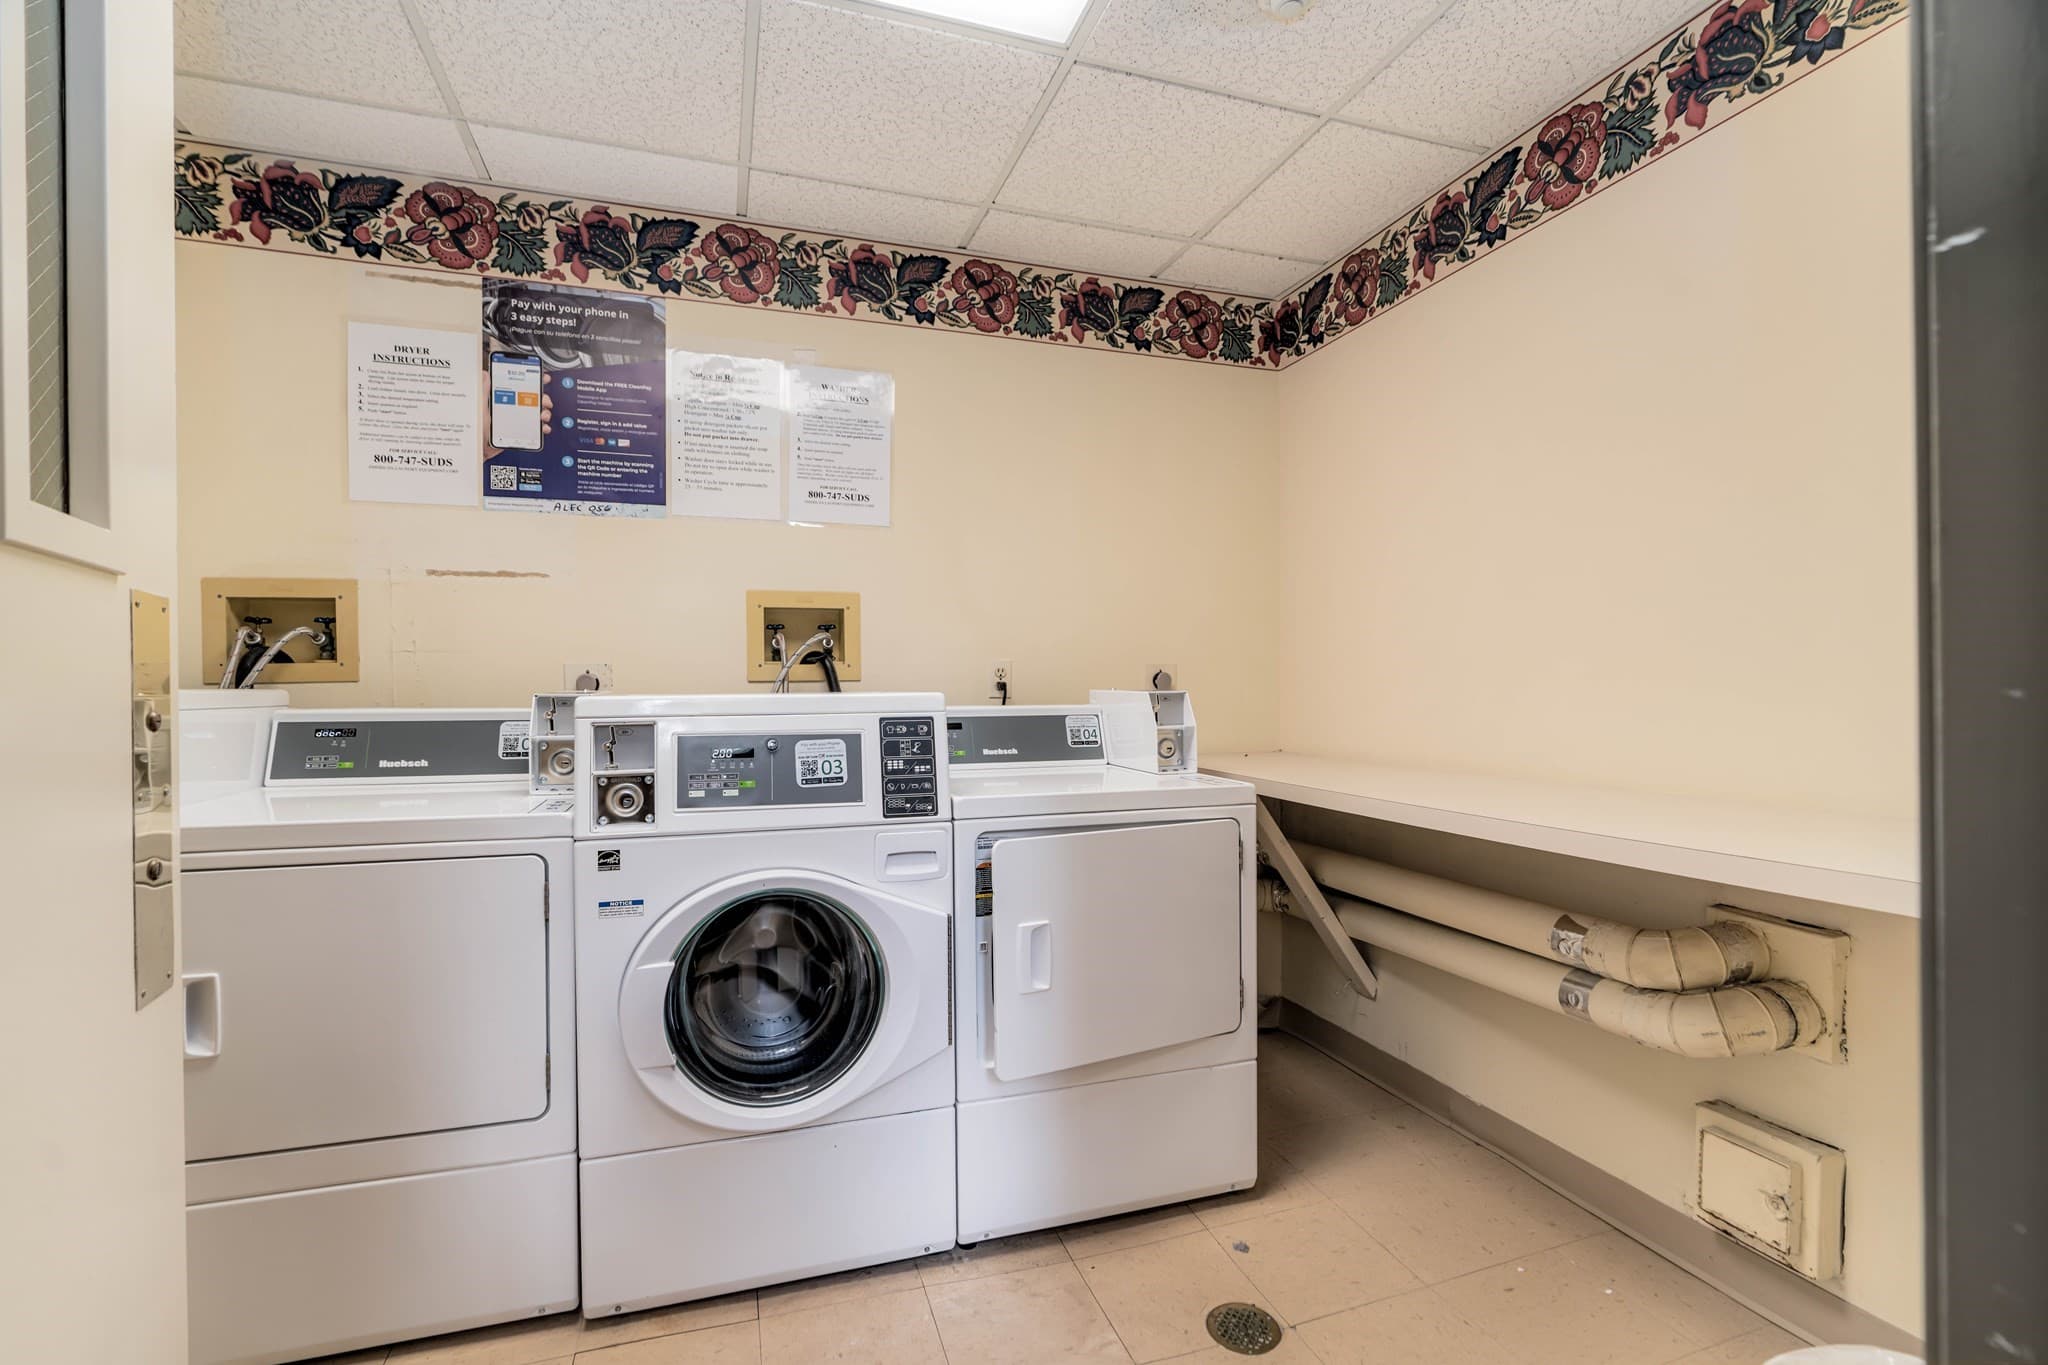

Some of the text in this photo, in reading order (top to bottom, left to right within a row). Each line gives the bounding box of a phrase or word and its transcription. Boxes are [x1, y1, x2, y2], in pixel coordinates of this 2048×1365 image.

[511, 299, 629, 319] Pay with your phone in
[511, 312, 577, 327] 3 easy steps!
[394, 345, 430, 355] DRYER
[373, 353, 451, 367] INSTRUCTIONS
[373, 454, 453, 467] 800-747-SUDS
[808, 491, 870, 502] 800-747-SUDS
[553, 502, 582, 512] ALEC
[1083, 729, 1098, 739] 04
[378, 759, 429, 768] Huebsch
[821, 759, 843, 775] 03
